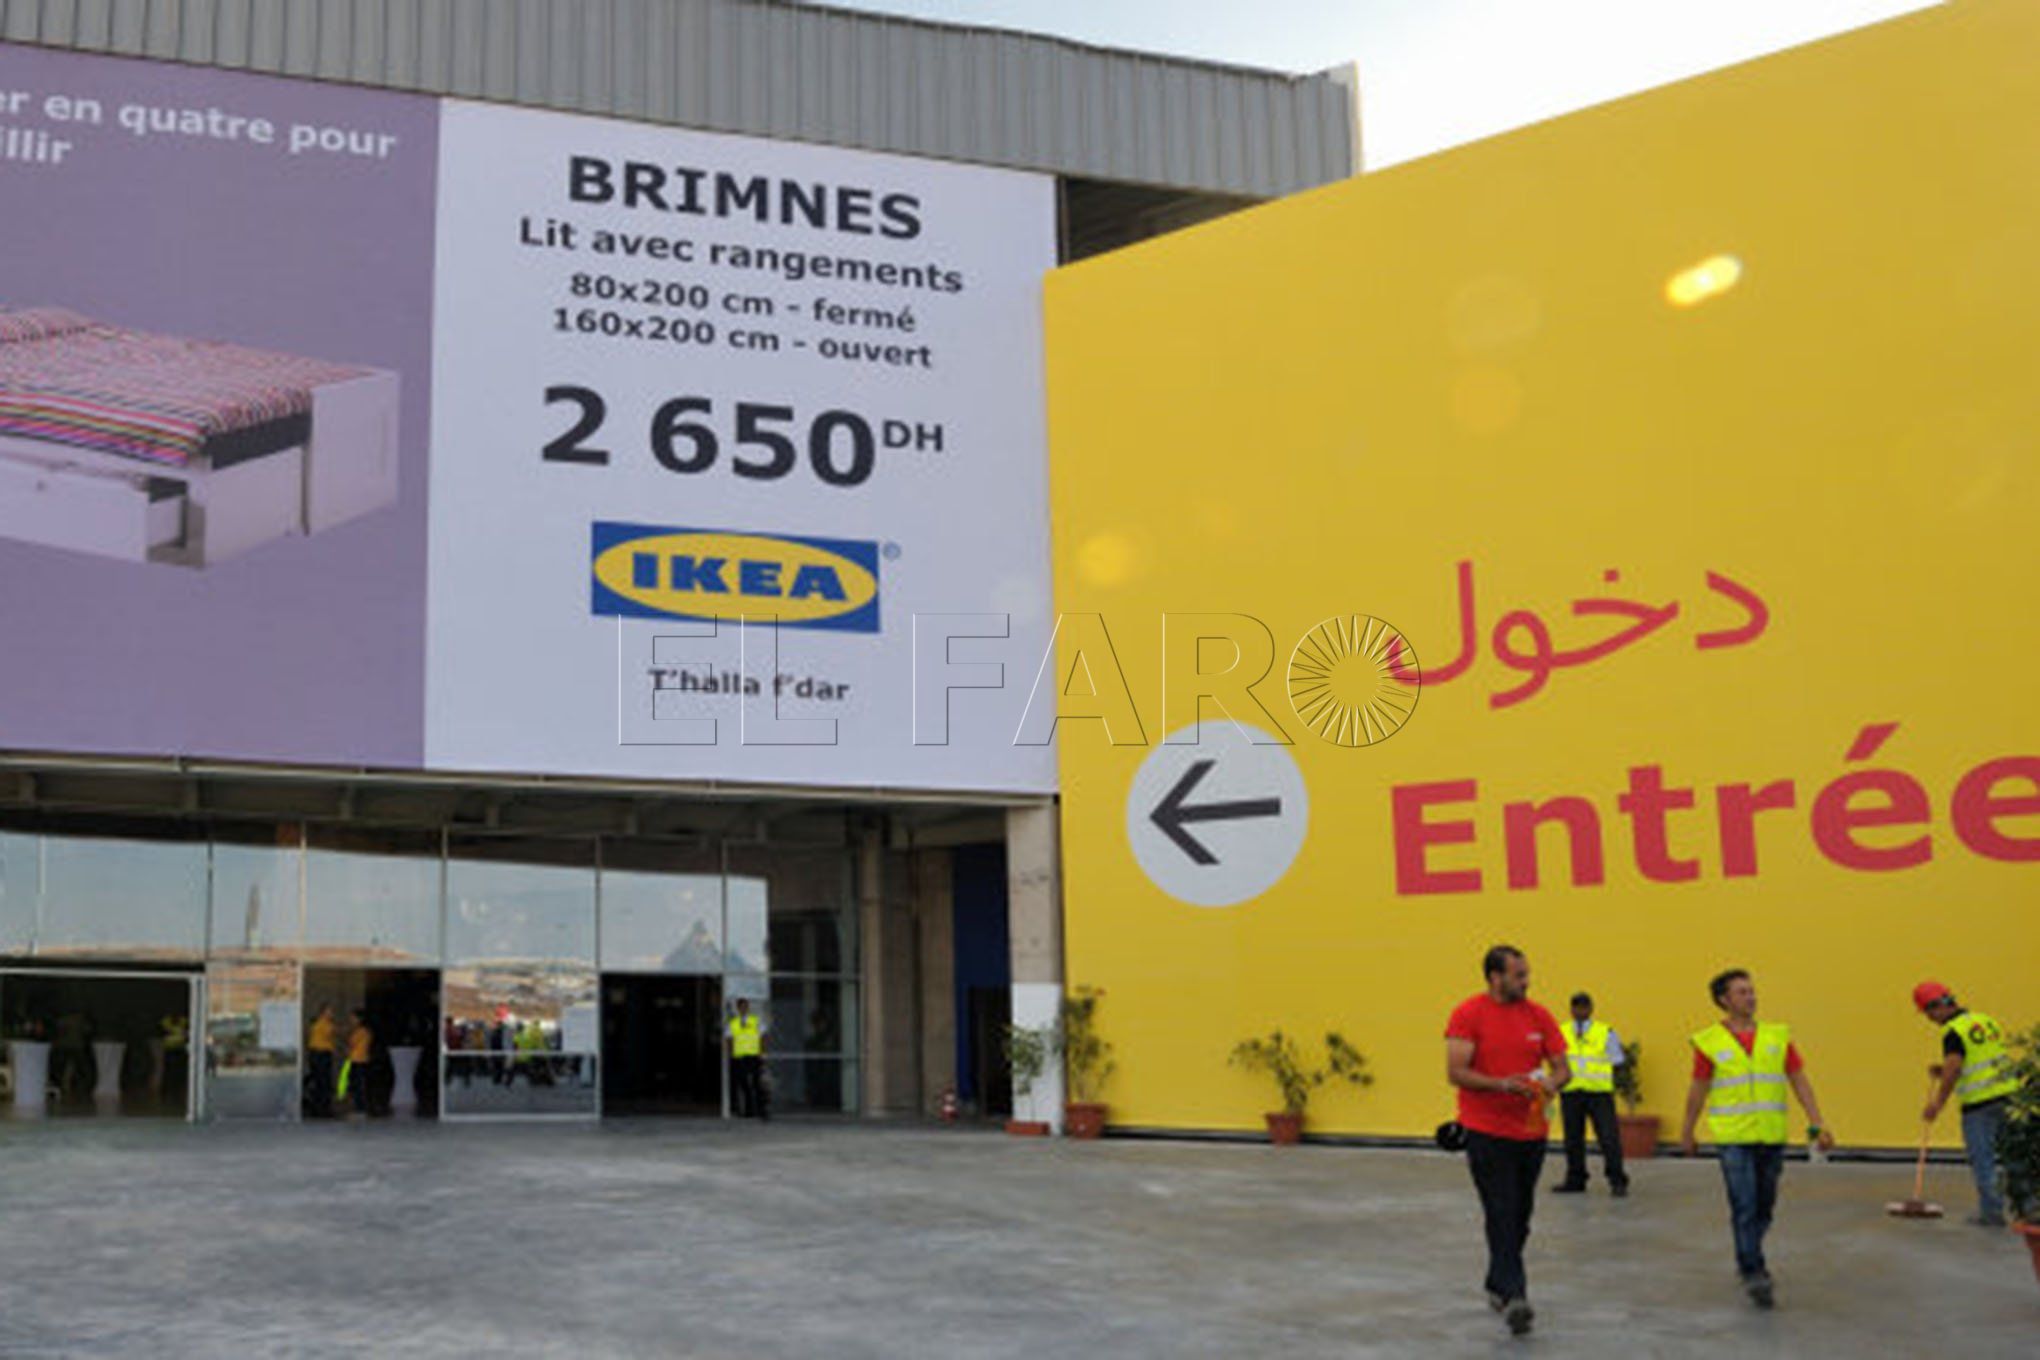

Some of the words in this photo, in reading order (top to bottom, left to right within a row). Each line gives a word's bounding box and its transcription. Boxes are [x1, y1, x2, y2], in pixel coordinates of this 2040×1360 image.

[0, 91, 30, 115] r
[44, 94, 102, 123] en
[118, 104, 275, 142] quatre
[289, 123, 397, 158] pour
[568, 156, 922, 240] BRIMNES
[520, 217, 577, 250] Lit
[591, 229, 694, 263] avec
[709, 243, 964, 295] rangements
[554, 308, 715, 346] 160x200
[728, 327, 780, 351] cm
[818, 336, 933, 369] ouvert
[570, 272, 709, 310] 80x200
[722, 292, 774, 316] cm
[813, 298, 917, 333] fermé
[541, 385, 610, 466] 2
[650, 396, 875, 488] 650
[882, 420, 944, 453] DH
[632, 551, 848, 602] IKEA
[1388, 560, 1769, 710] دخول
[1391, 722, 2040, 896] Entrée
